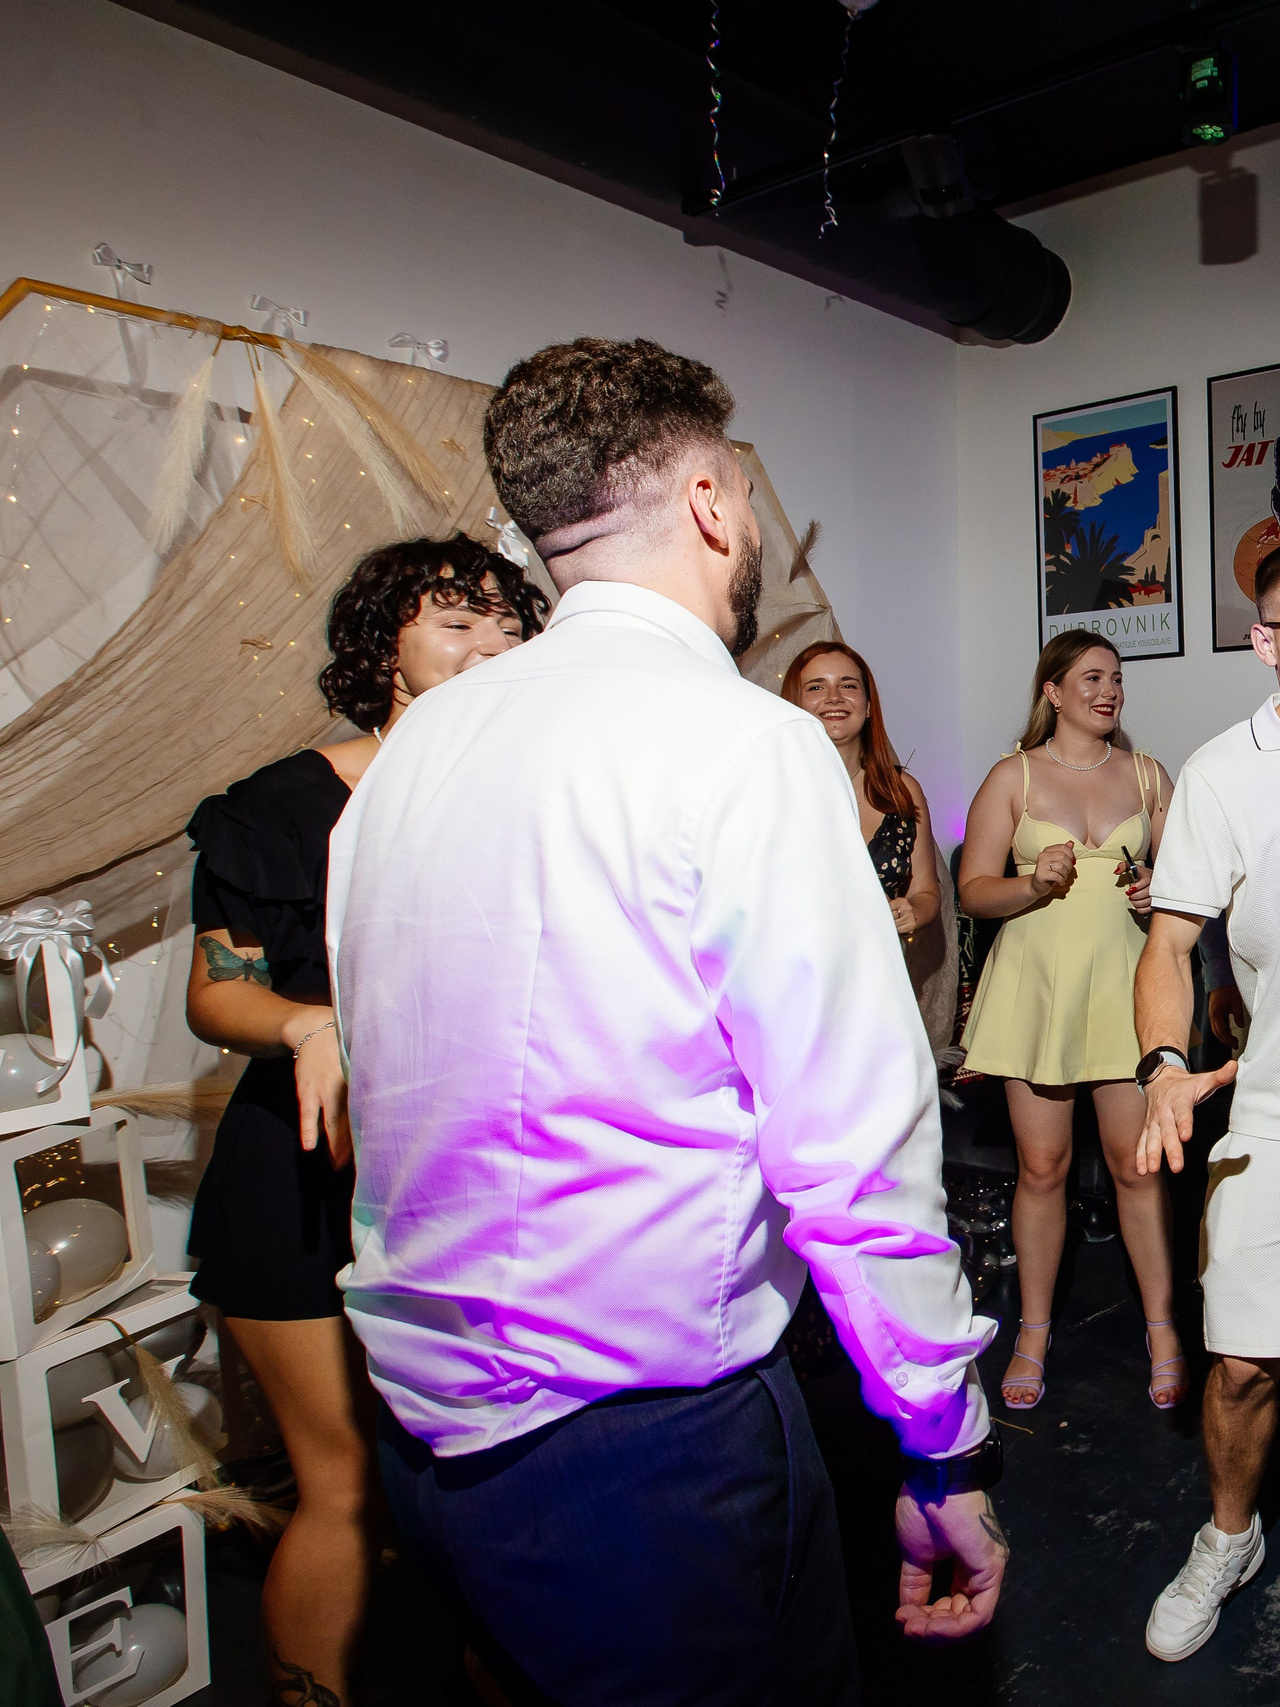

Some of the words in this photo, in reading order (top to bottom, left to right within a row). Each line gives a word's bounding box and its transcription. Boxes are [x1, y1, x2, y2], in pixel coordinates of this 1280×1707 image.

[1231, 404, 1247, 443] fly
[1254, 401, 1266, 438] by
[1221, 440, 1275, 468] JAT
[1137, 637, 1172, 648] YOUGOSLAVIE
